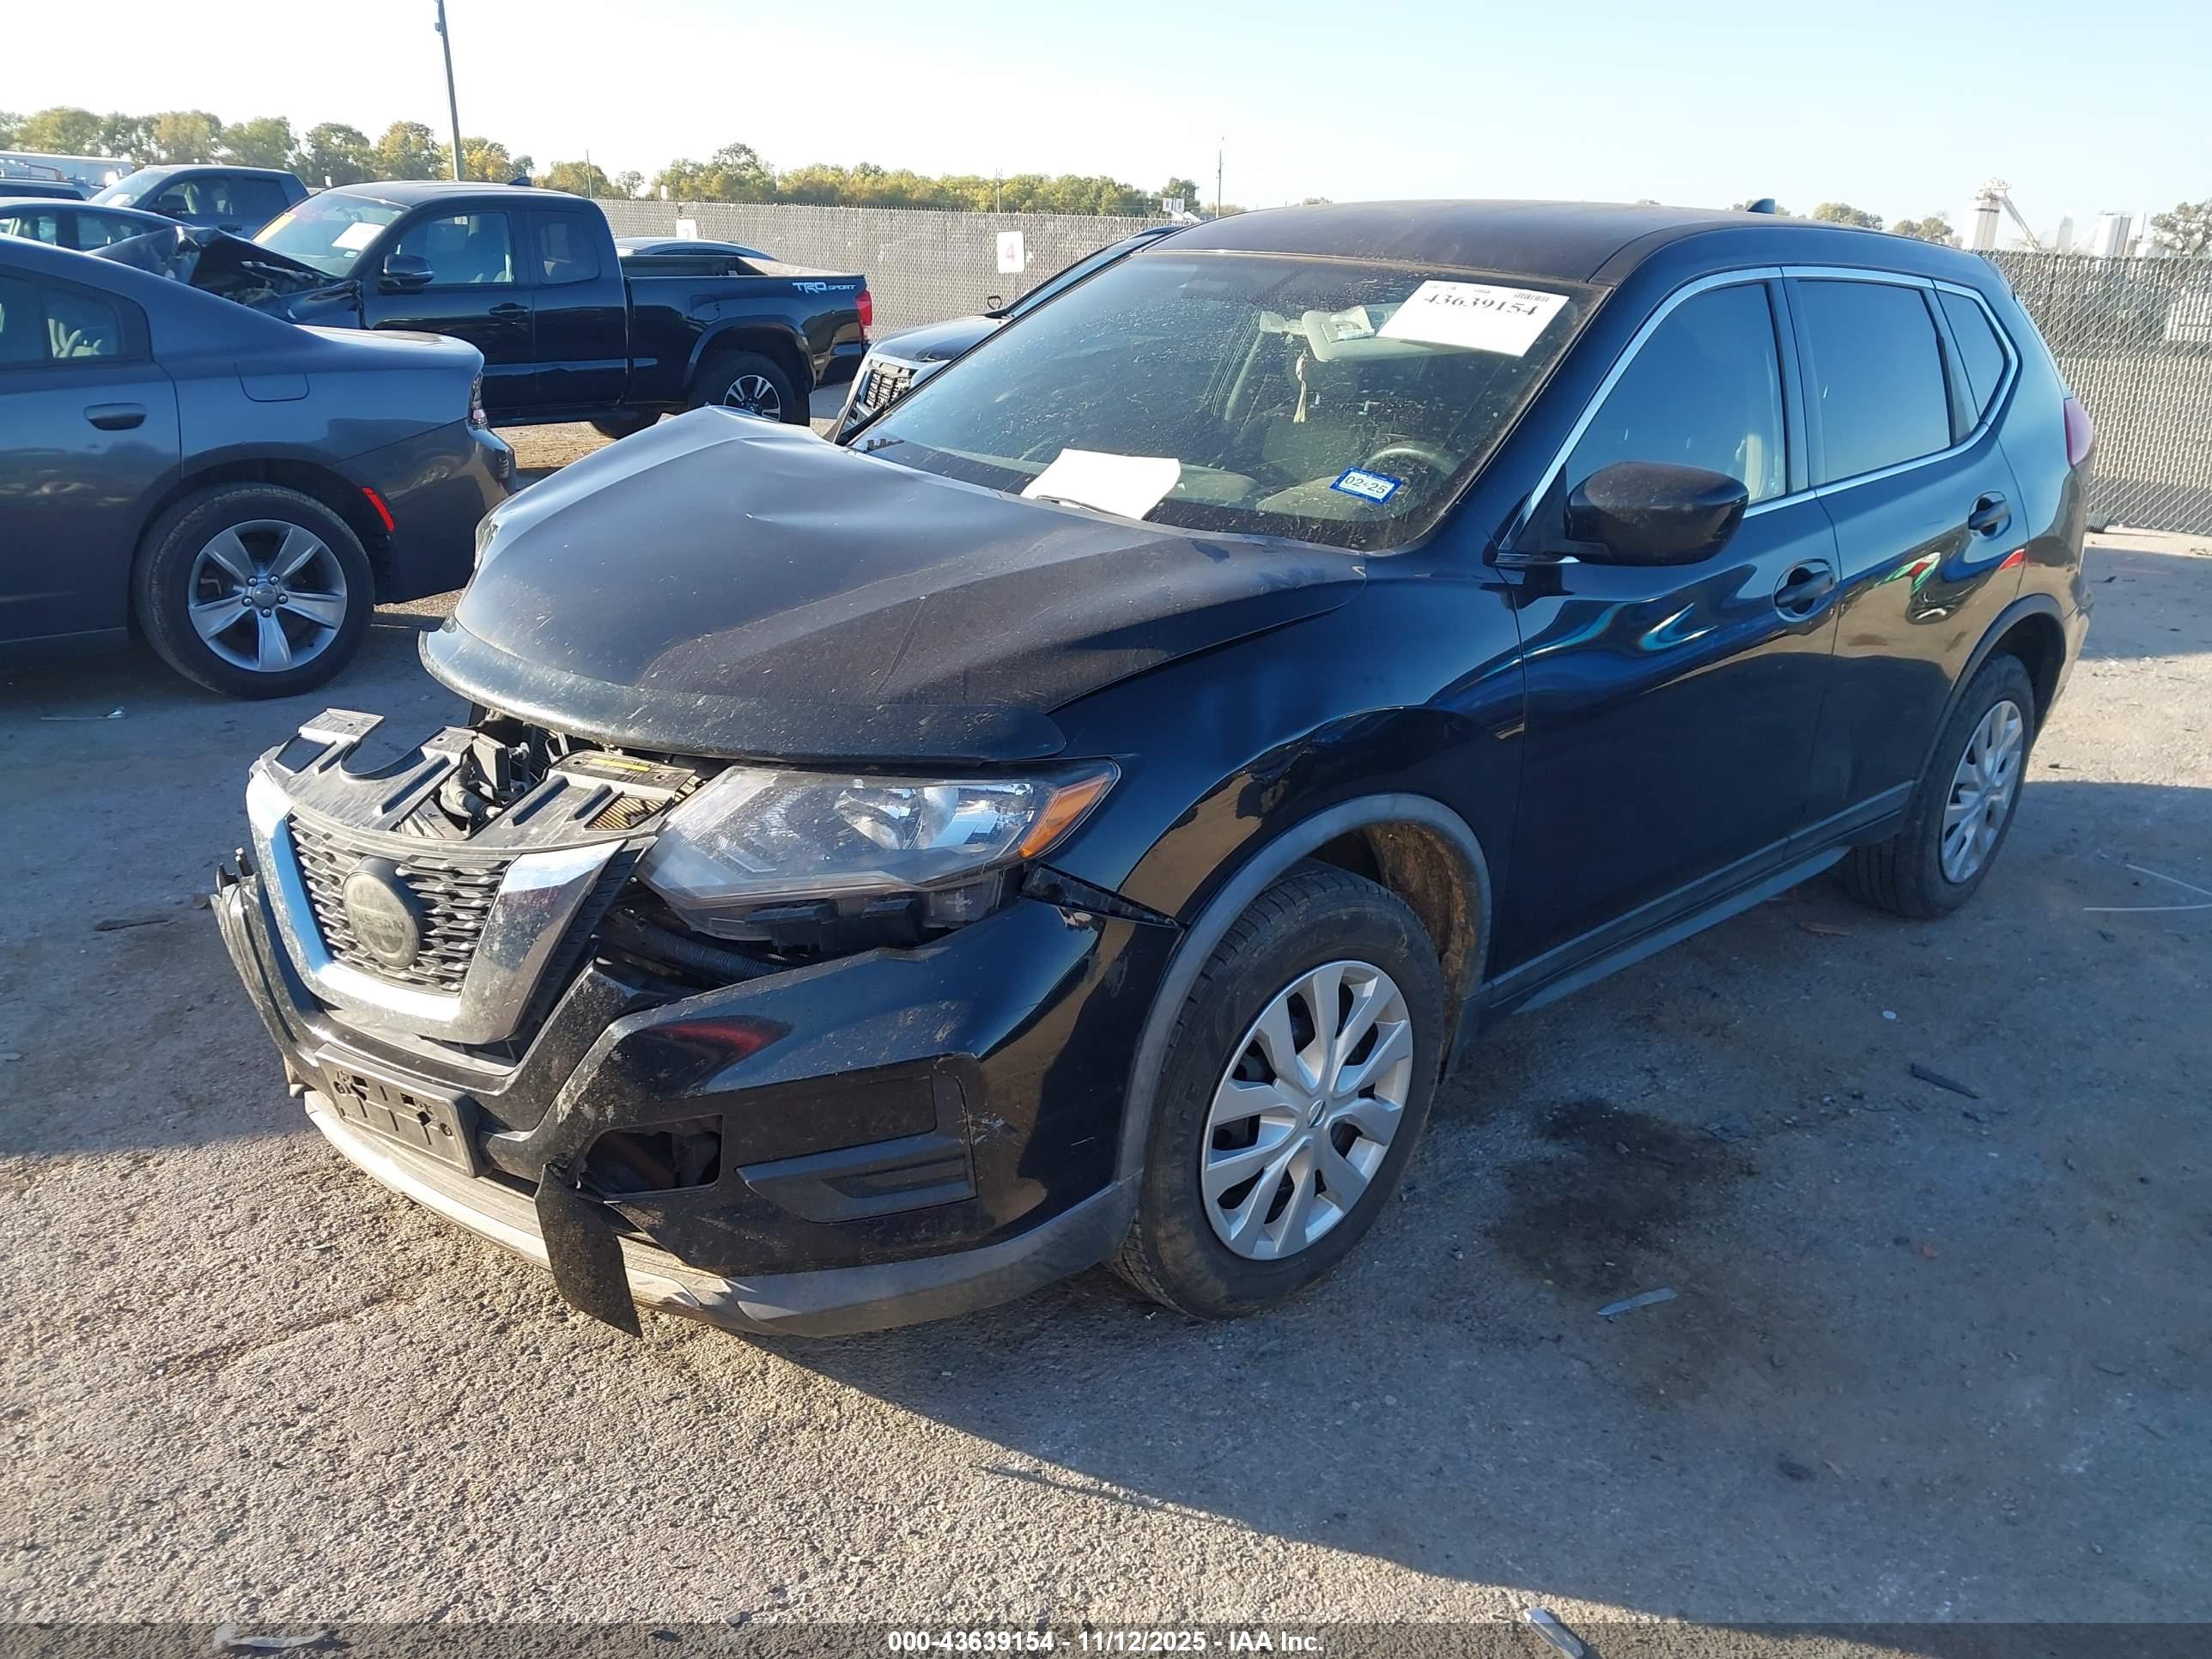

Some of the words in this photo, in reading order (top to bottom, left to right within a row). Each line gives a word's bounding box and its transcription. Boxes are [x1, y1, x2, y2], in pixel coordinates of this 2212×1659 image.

[1006, 241, 1016, 261] 4
[792, 282, 827, 294] TRD
[1424, 293, 1538, 316] 43639154
